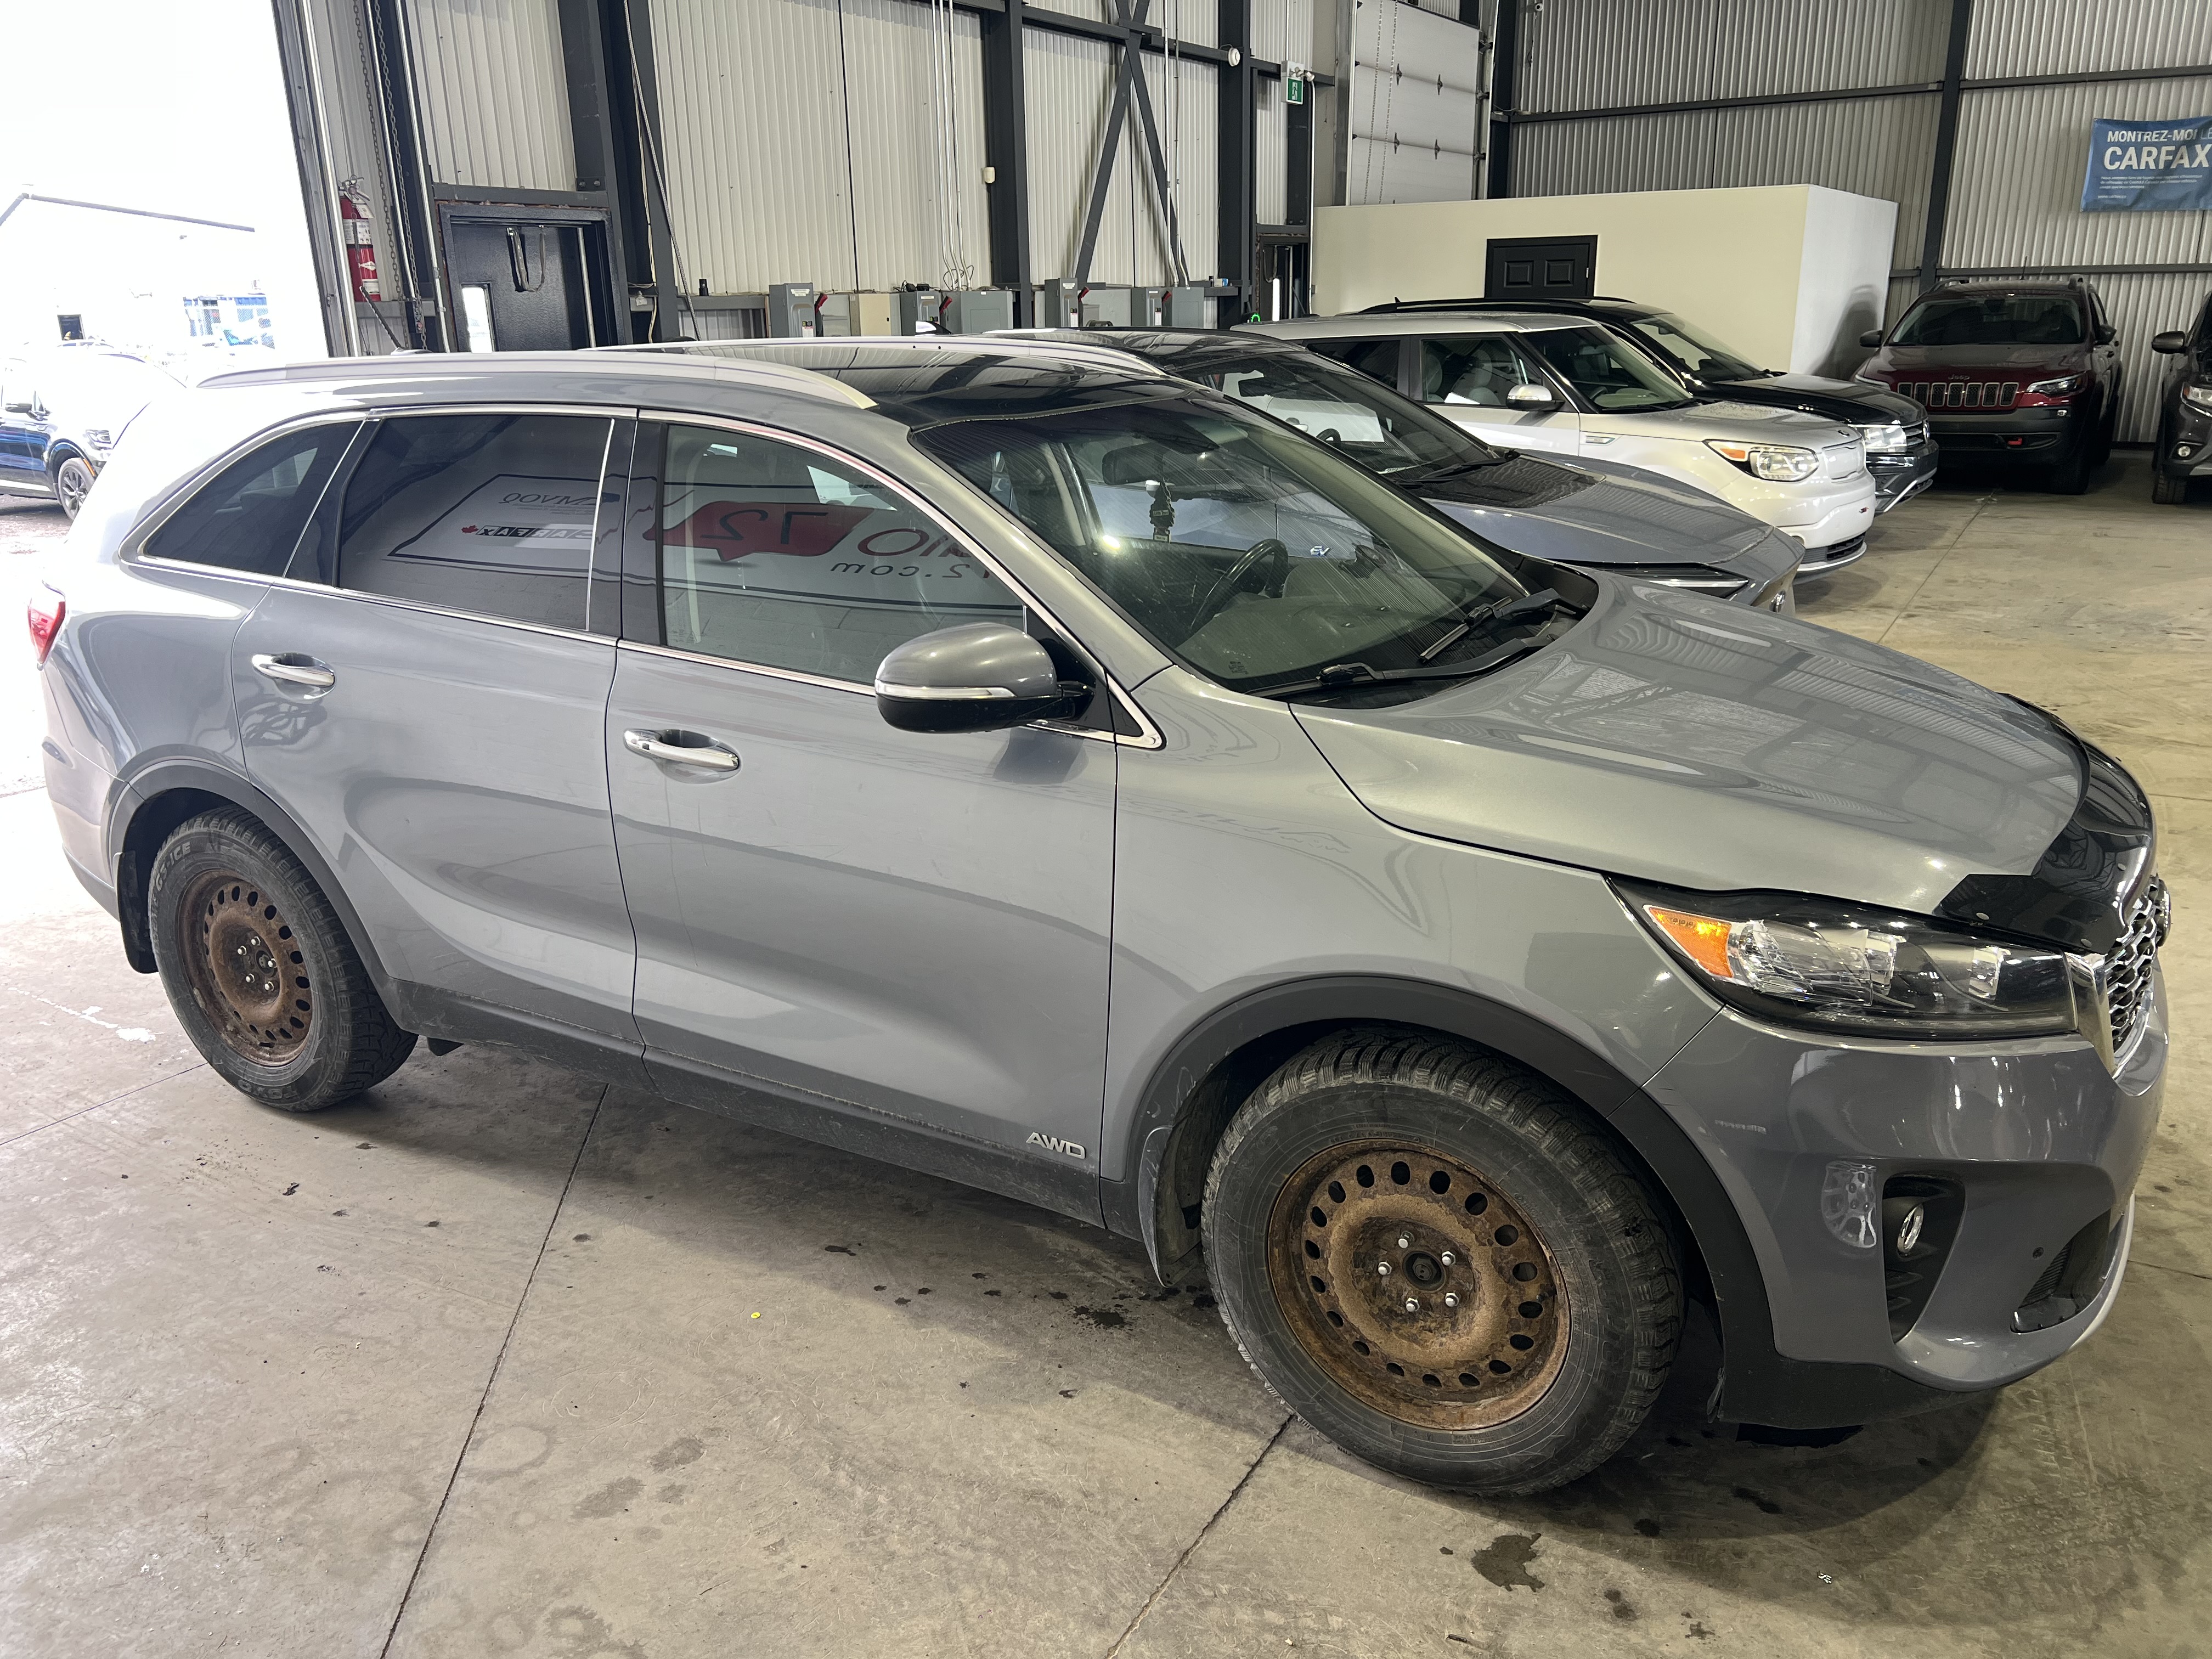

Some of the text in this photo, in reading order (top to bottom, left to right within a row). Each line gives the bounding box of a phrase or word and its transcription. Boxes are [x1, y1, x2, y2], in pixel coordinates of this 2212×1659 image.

[2107, 129, 2198, 143] MONTREZ-MOI
[2103, 144, 2212, 170] CARFAX
[1026, 1132, 1086, 1159] AWD
